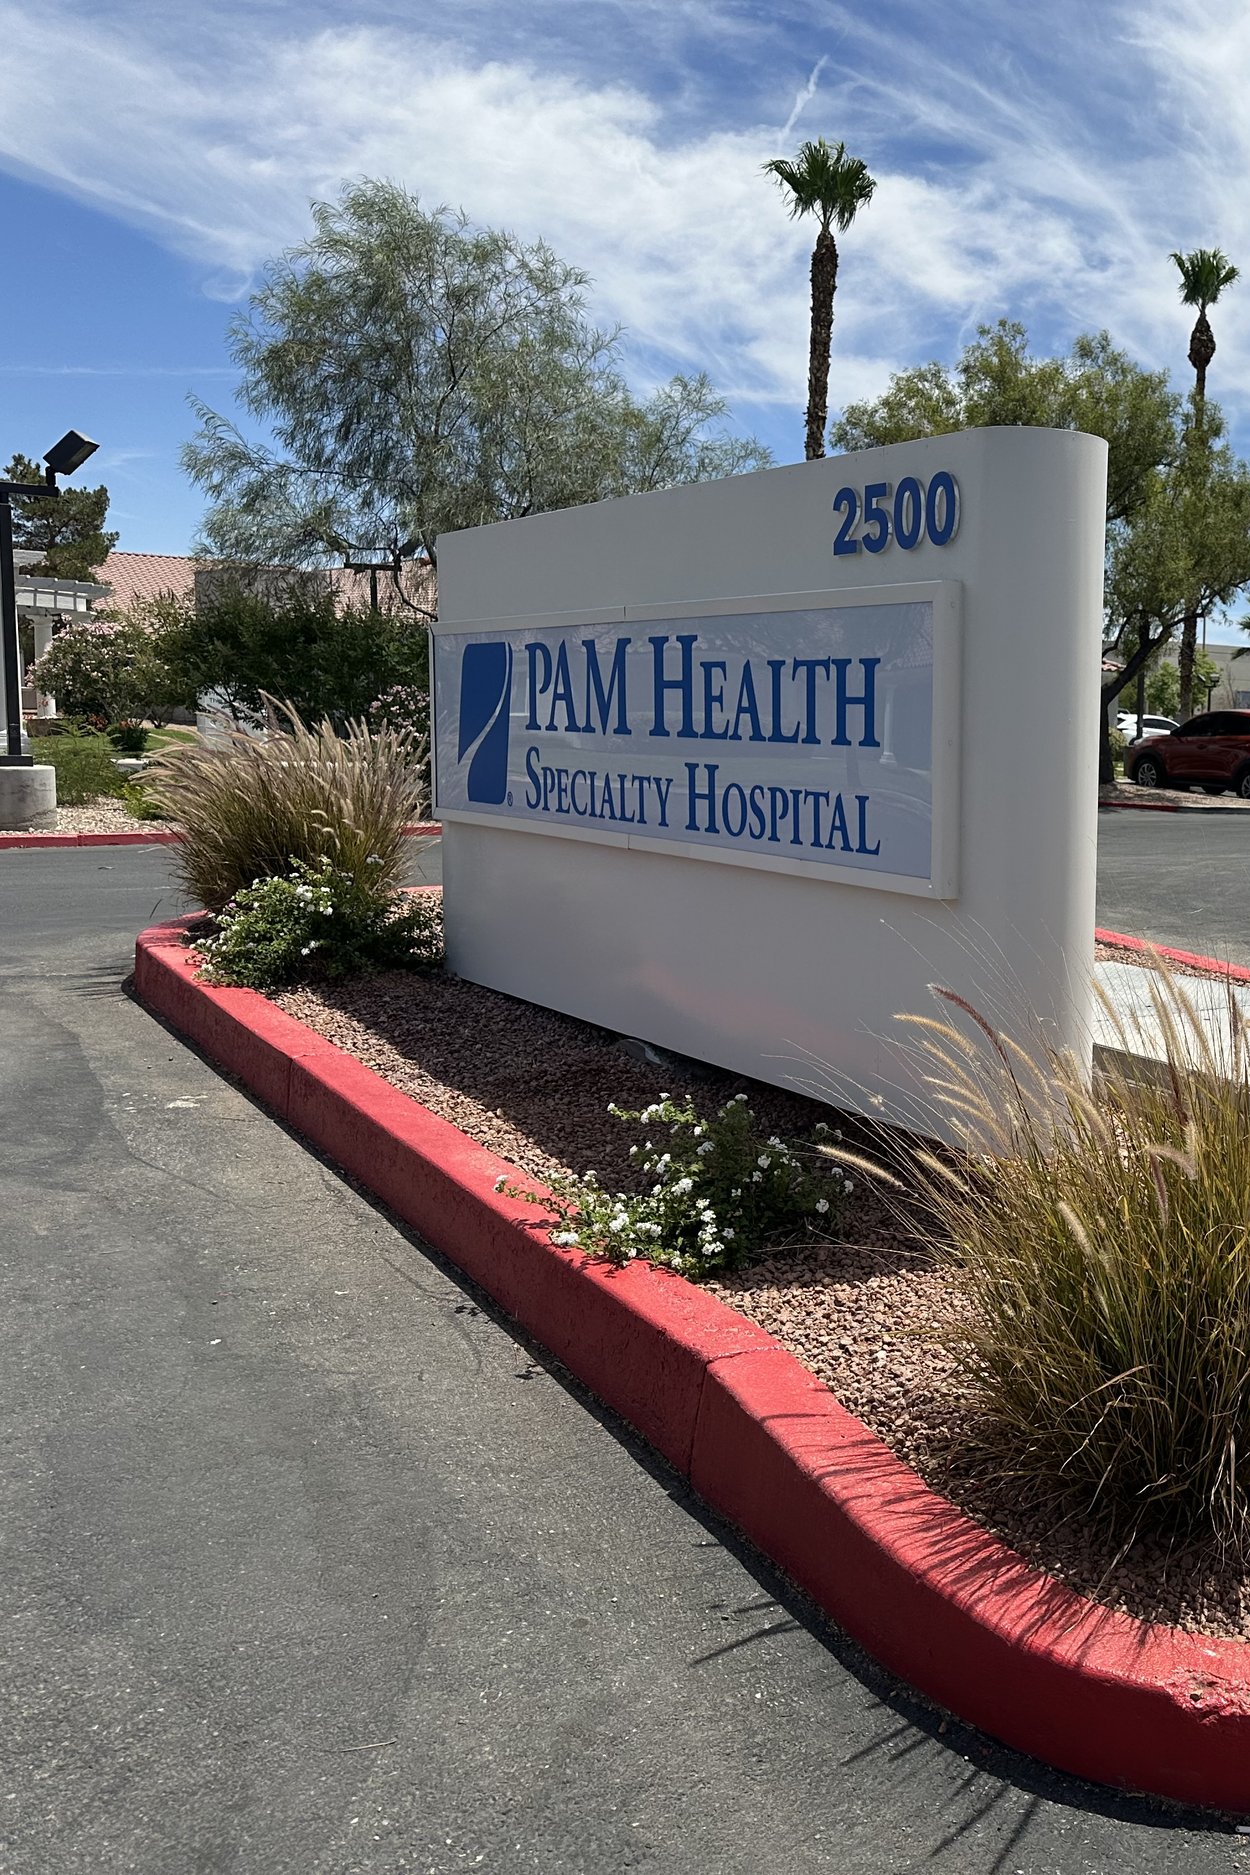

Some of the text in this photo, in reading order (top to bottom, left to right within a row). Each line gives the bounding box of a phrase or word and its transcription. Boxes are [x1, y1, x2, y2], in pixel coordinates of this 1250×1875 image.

[832, 471, 958, 555] 2500
[525, 634, 881, 748] PAM HEALTH
[525, 745, 881, 856] SPECIALTY HOSPITAL
